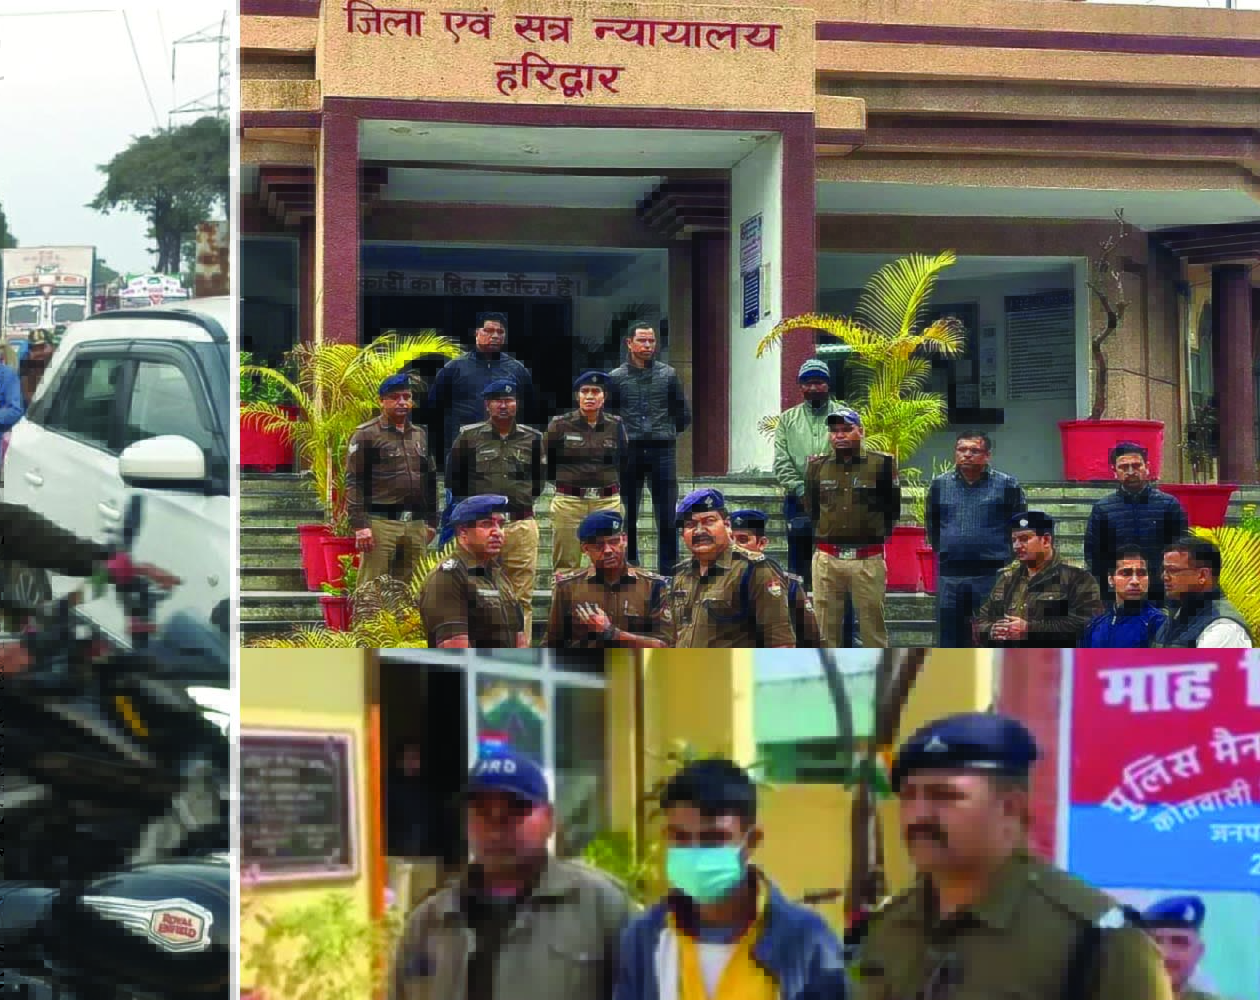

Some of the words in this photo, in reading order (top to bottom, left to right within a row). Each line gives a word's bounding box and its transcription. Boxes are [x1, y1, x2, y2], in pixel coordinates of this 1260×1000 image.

[343, 1, 425, 37] जिला
[440, 6, 495, 43] एवं
[514, 13, 574, 43] सत्र
[593, 17, 782, 51] न्यायालय
[494, 51, 625, 97] हरिद्वार
[1097, 662, 1218, 712] माह
[1101, 746, 1202, 822] पुलिस
[1151, 777, 1254, 832] कोतवाली
